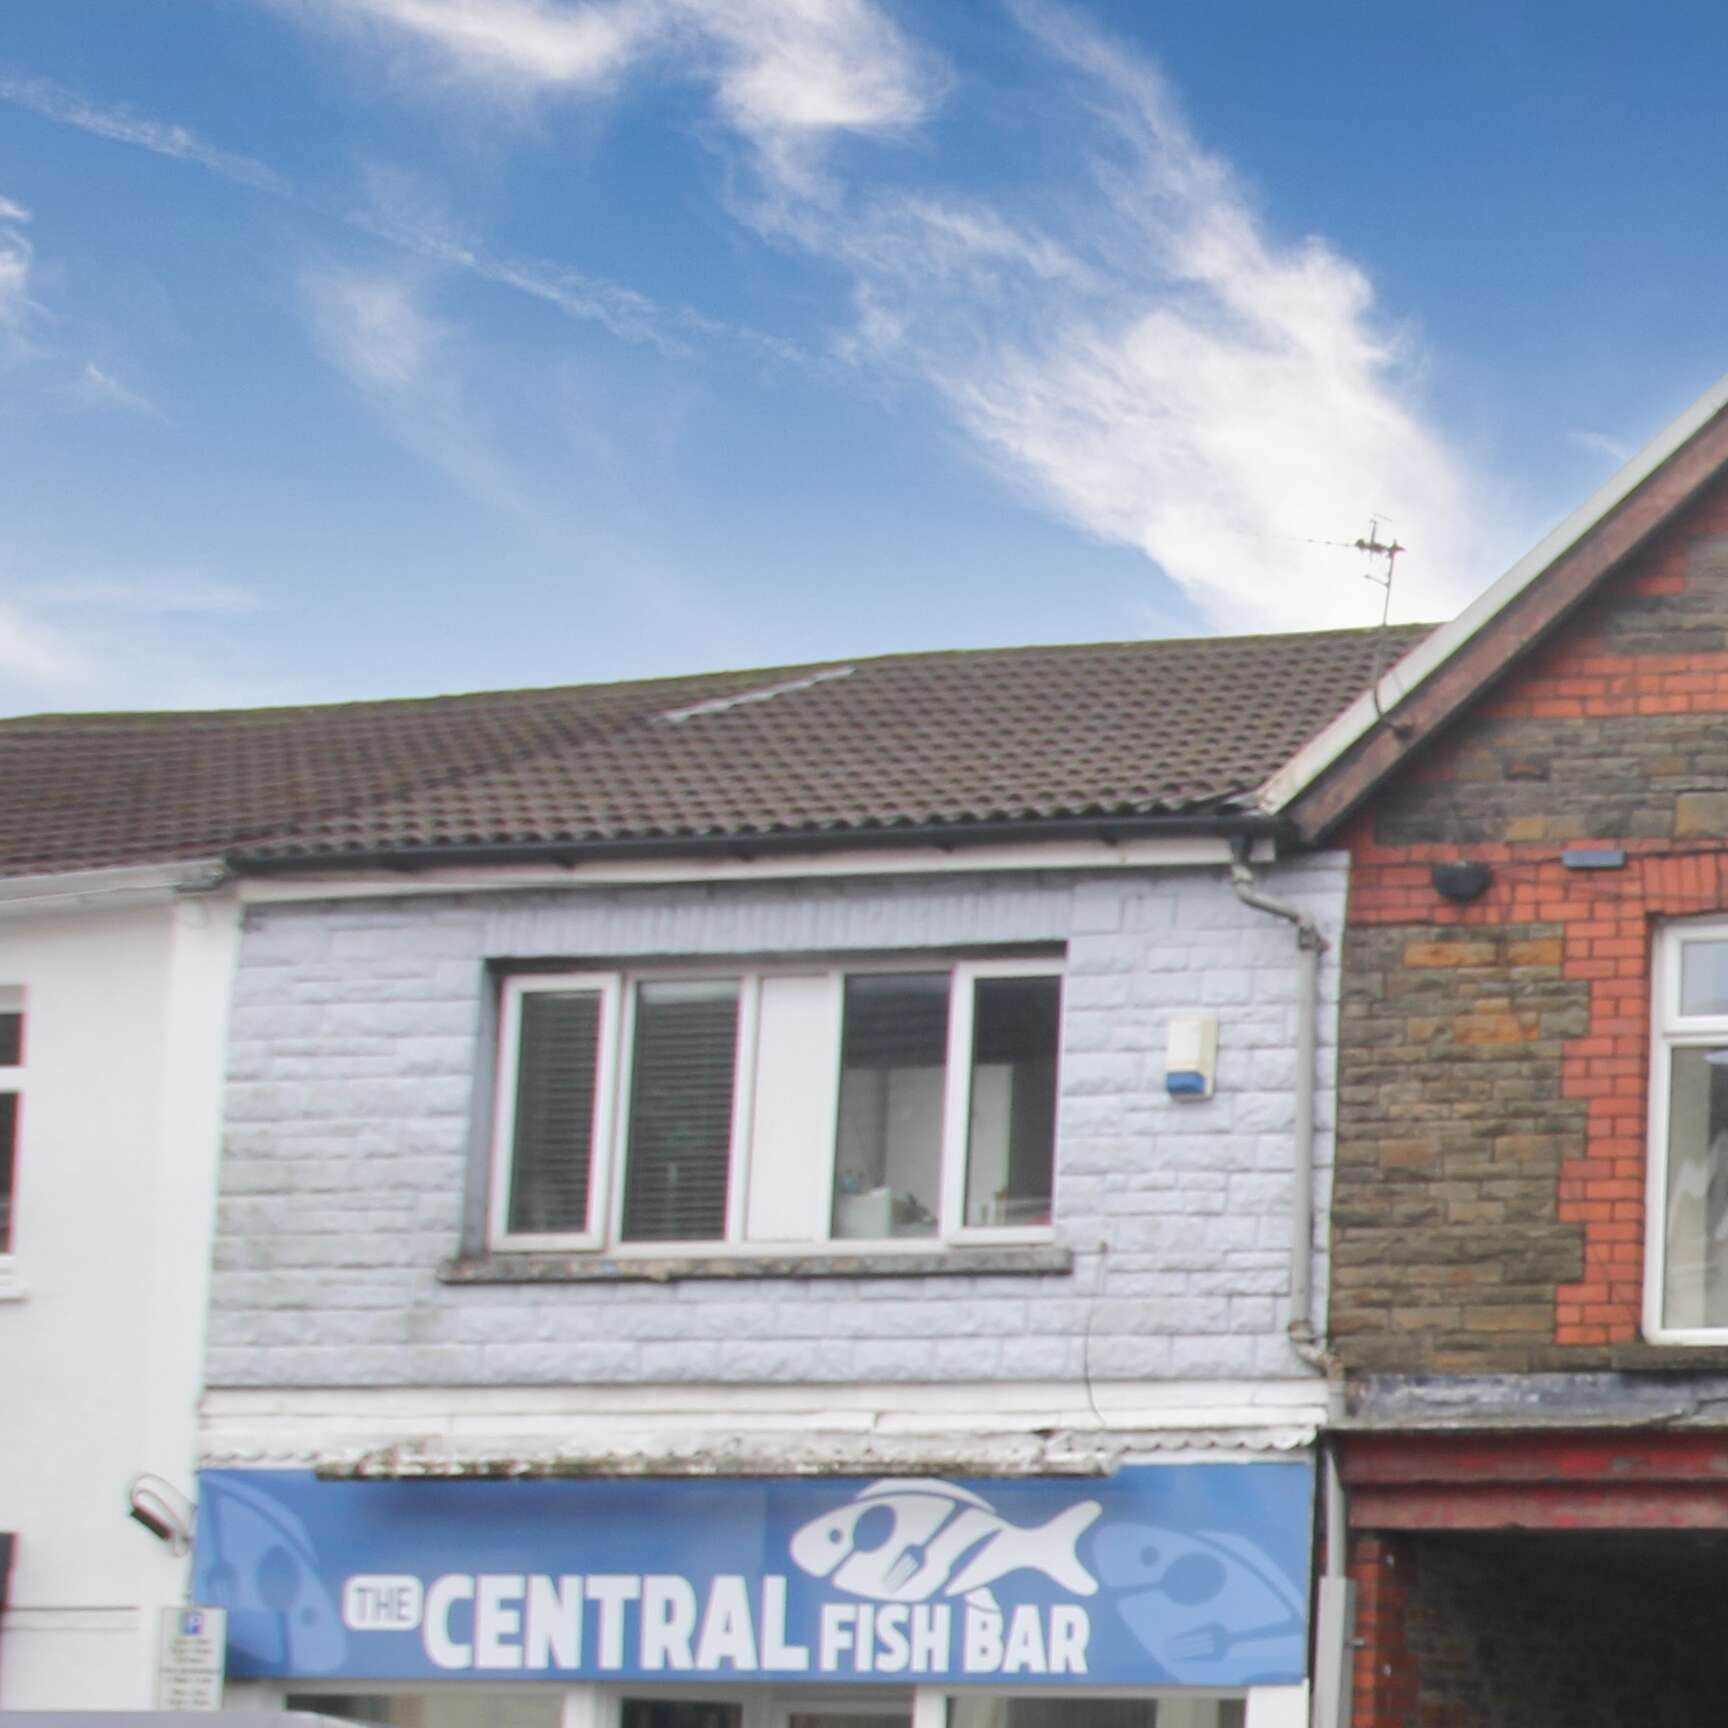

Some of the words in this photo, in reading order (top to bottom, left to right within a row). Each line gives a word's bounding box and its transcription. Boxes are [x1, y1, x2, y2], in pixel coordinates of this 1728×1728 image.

[355, 1586, 412, 1623] THE
[422, 1574, 809, 1672] CENTRAL
[818, 1604, 948, 1674] FISH
[966, 1604, 1091, 1675] BAR
